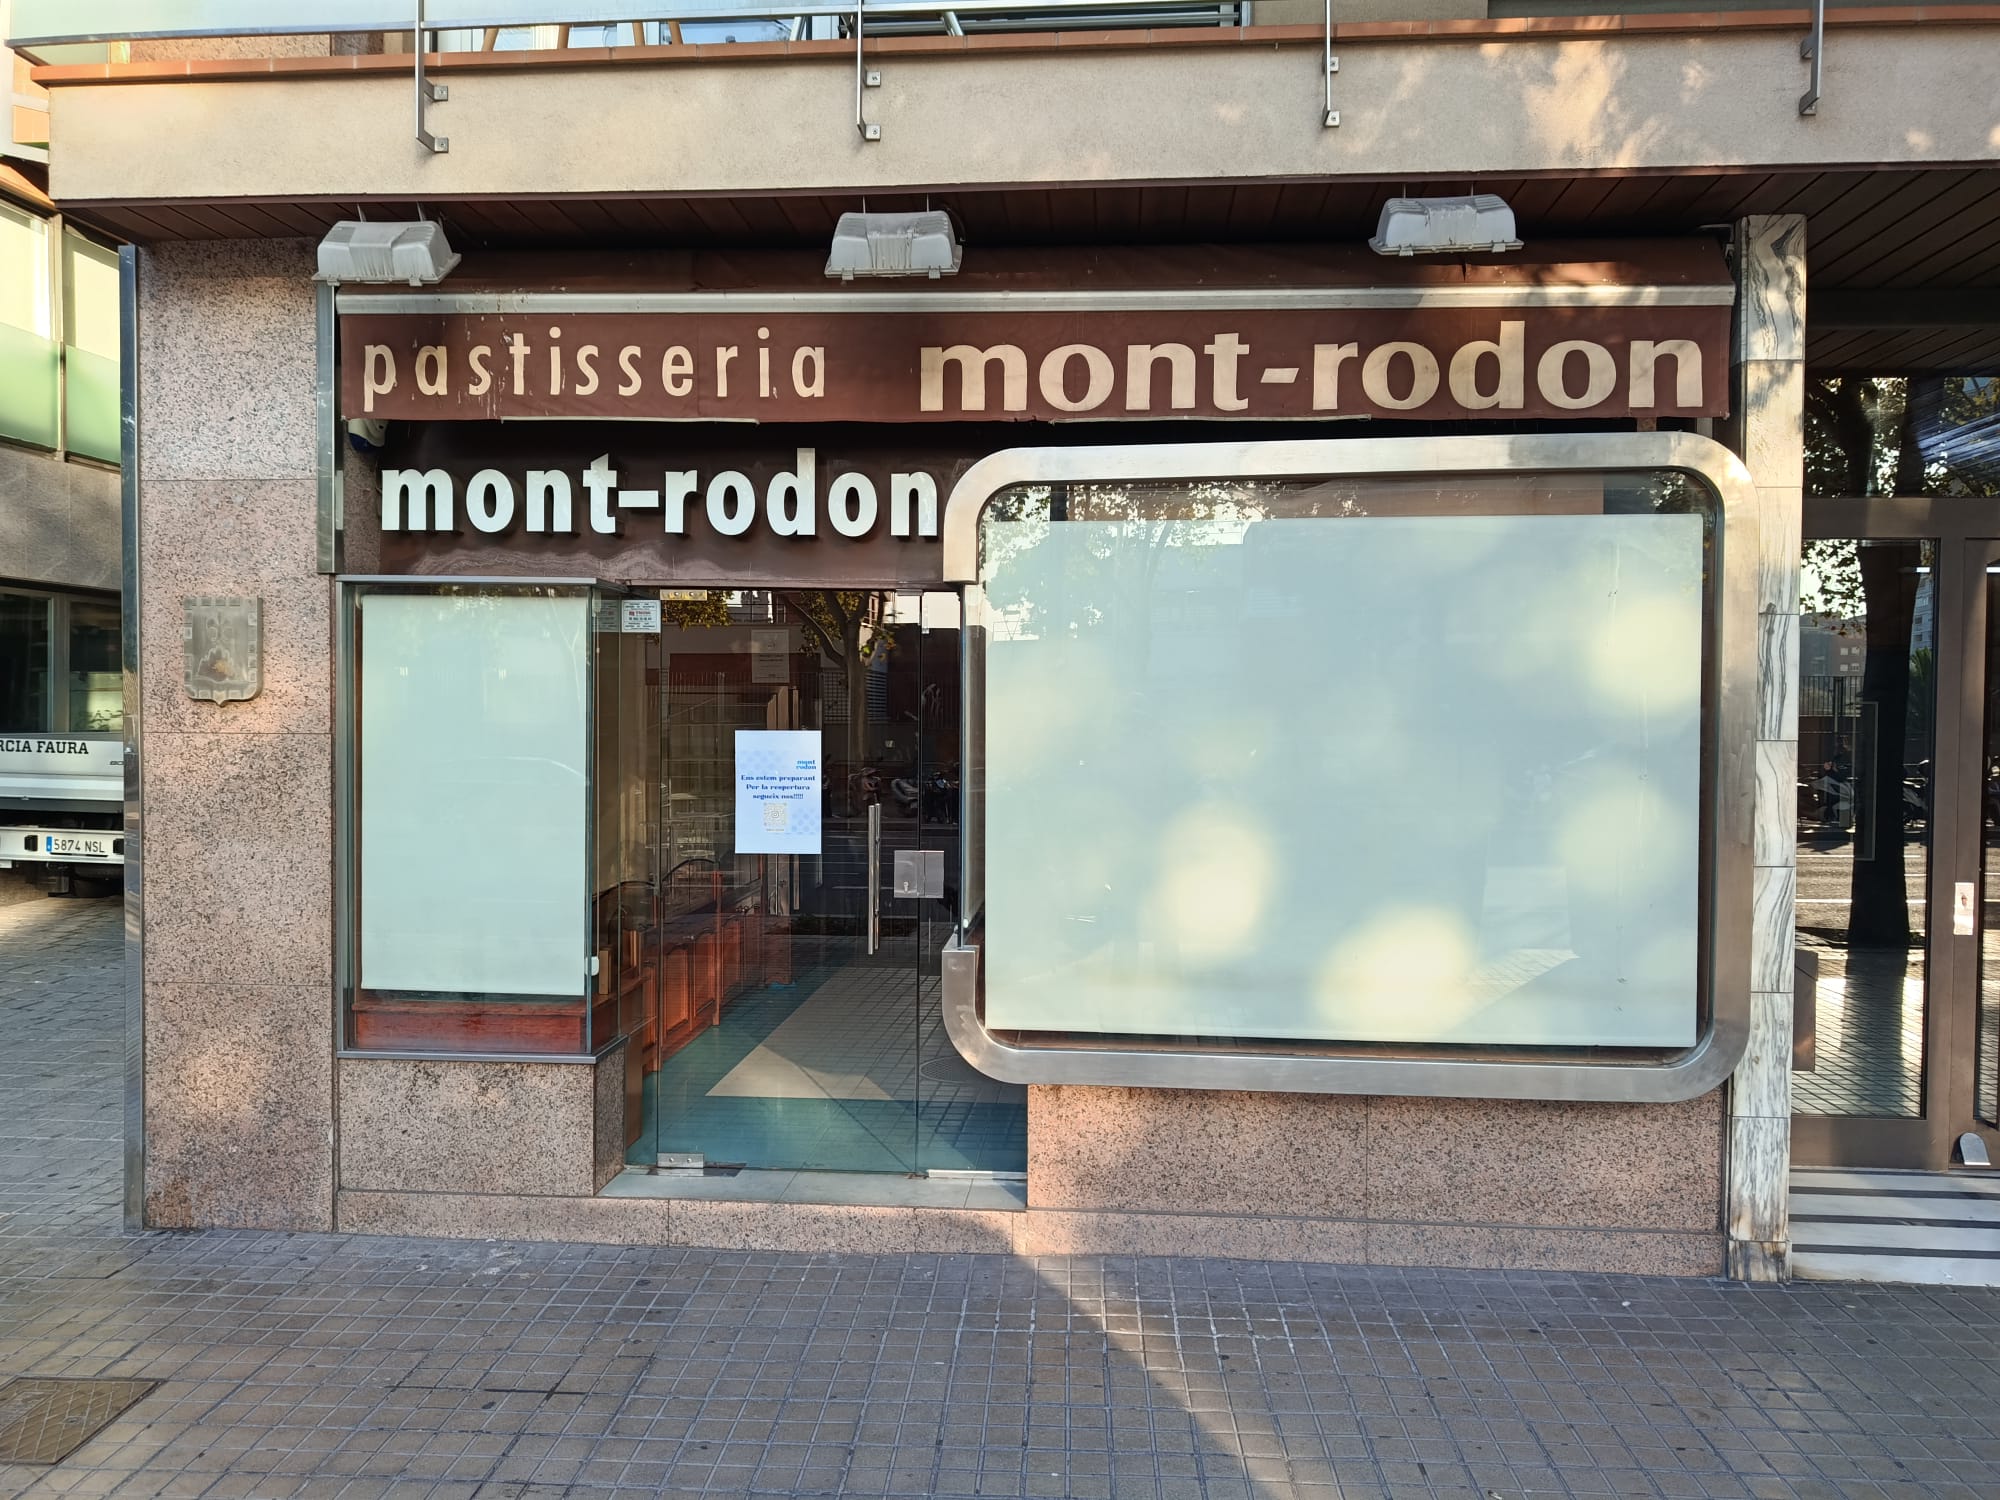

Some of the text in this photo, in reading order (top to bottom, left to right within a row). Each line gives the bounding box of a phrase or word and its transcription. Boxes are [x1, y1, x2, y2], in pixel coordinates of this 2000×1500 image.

[363, 320, 1704, 413] pastisseria mont-rodon
[380, 447, 938, 538] mont-rodon
[36, 741, 89, 755] FAURA
[779, 775, 816, 783] preparant
[54, 838, 105, 853] 5874 NSL
